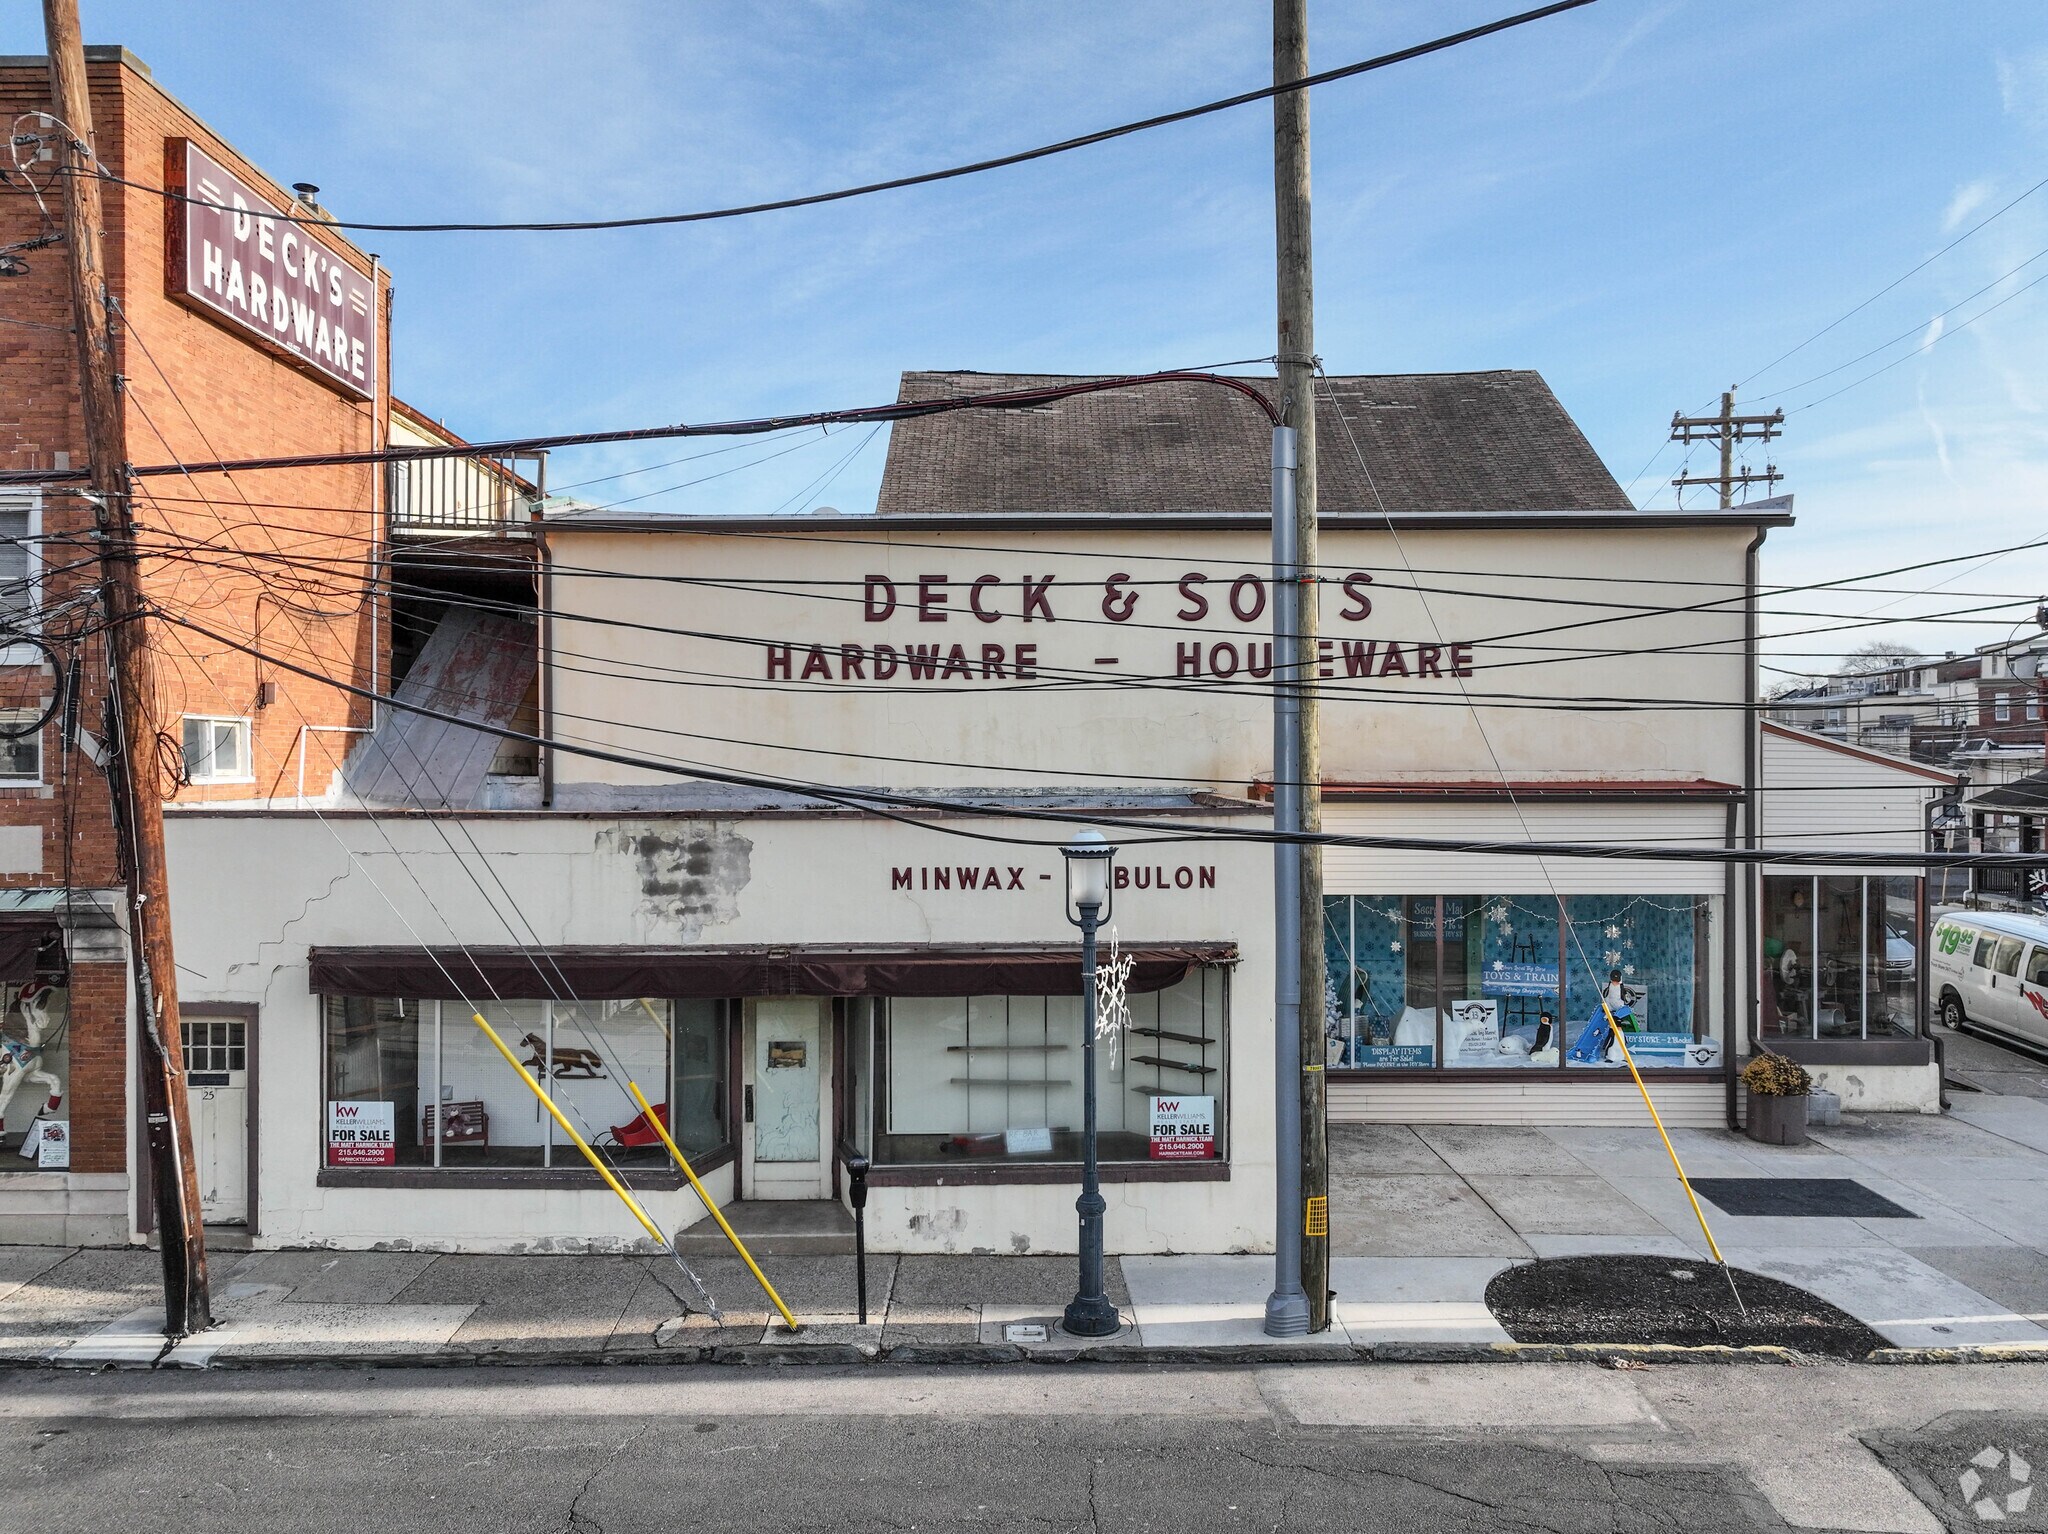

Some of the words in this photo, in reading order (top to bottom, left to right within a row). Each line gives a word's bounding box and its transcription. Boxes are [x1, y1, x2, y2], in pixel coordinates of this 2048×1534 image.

[234, 191, 343, 308] DECK'S
[203, 238, 366, 382] HARDWARE
[864, 574, 1056, 623] DECK
[1101, 572, 1140, 622] &
[1177, 572, 1374, 623] SOS
[767, 643, 1038, 680] HARDWARE
[1177, 641, 1473, 679] HOUEWARE
[891, 866, 1025, 891] MINWAX
[1103, 866, 1216, 890] BULON
[1484, 971, 1511, 980] TOYS
[1513, 972, 1521, 981] &
[1525, 973, 1560, 982] TRAIN
[1638, 1035, 1660, 1043] STORE
[1371, 1047, 1400, 1056] DISPLAY
[1400, 1047, 1422, 1055] ITEMS
[202, 1091, 215, 1101] 25
[336, 1101, 360, 1118] kw
[1157, 1097, 1180, 1112] kw
[332, 1130, 356, 1141] FOR
[360, 1130, 390, 1141] SALE
[1153, 1125, 1176, 1135] FOR
[1180, 1124, 1210, 1135] SALE
